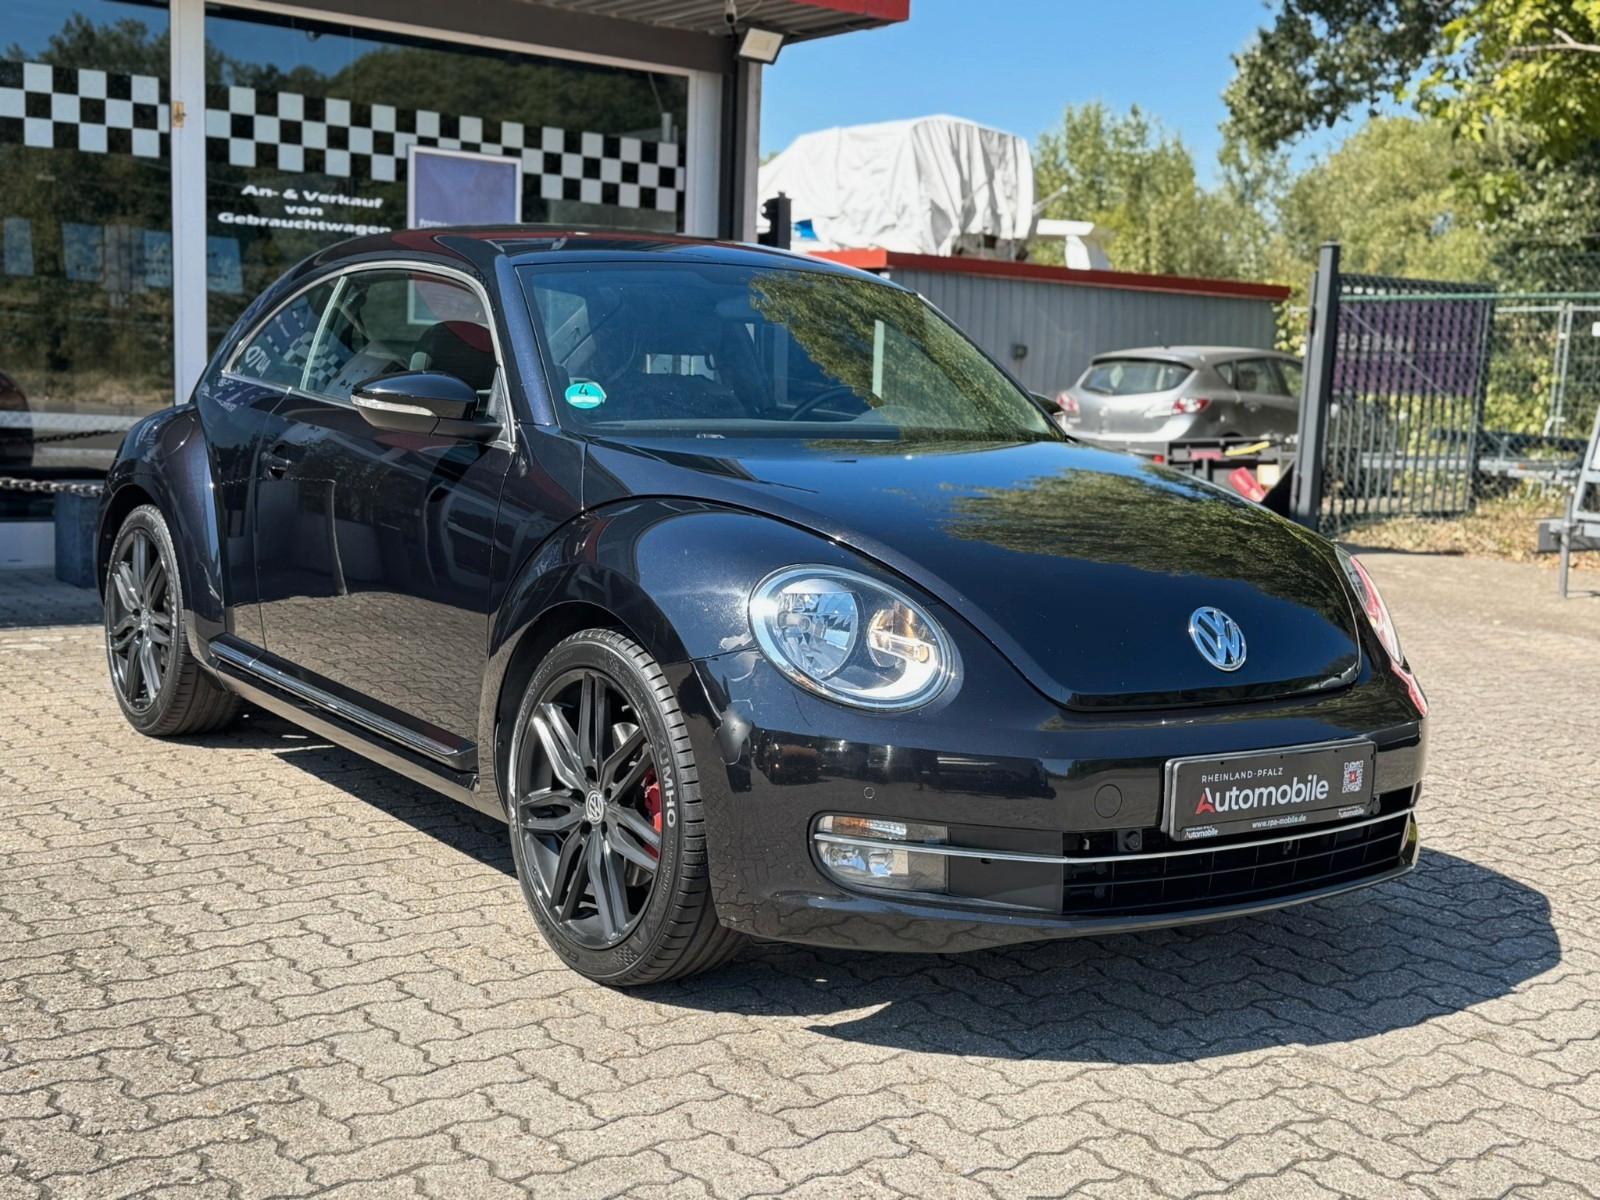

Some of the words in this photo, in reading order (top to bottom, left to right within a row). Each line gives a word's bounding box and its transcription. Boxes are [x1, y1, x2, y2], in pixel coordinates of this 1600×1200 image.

[241, 184, 279, 198] An-
[283, 188, 299, 200] &
[302, 190, 384, 209] Verkauf
[284, 205, 324, 217] von
[578, 384, 589, 396] 4
[1201, 767, 1284, 784] RHEINLAND-PFALZ
[1195, 774, 1330, 815] Automobile
[1252, 814, 1307, 829] www.rpa-mobile.de
